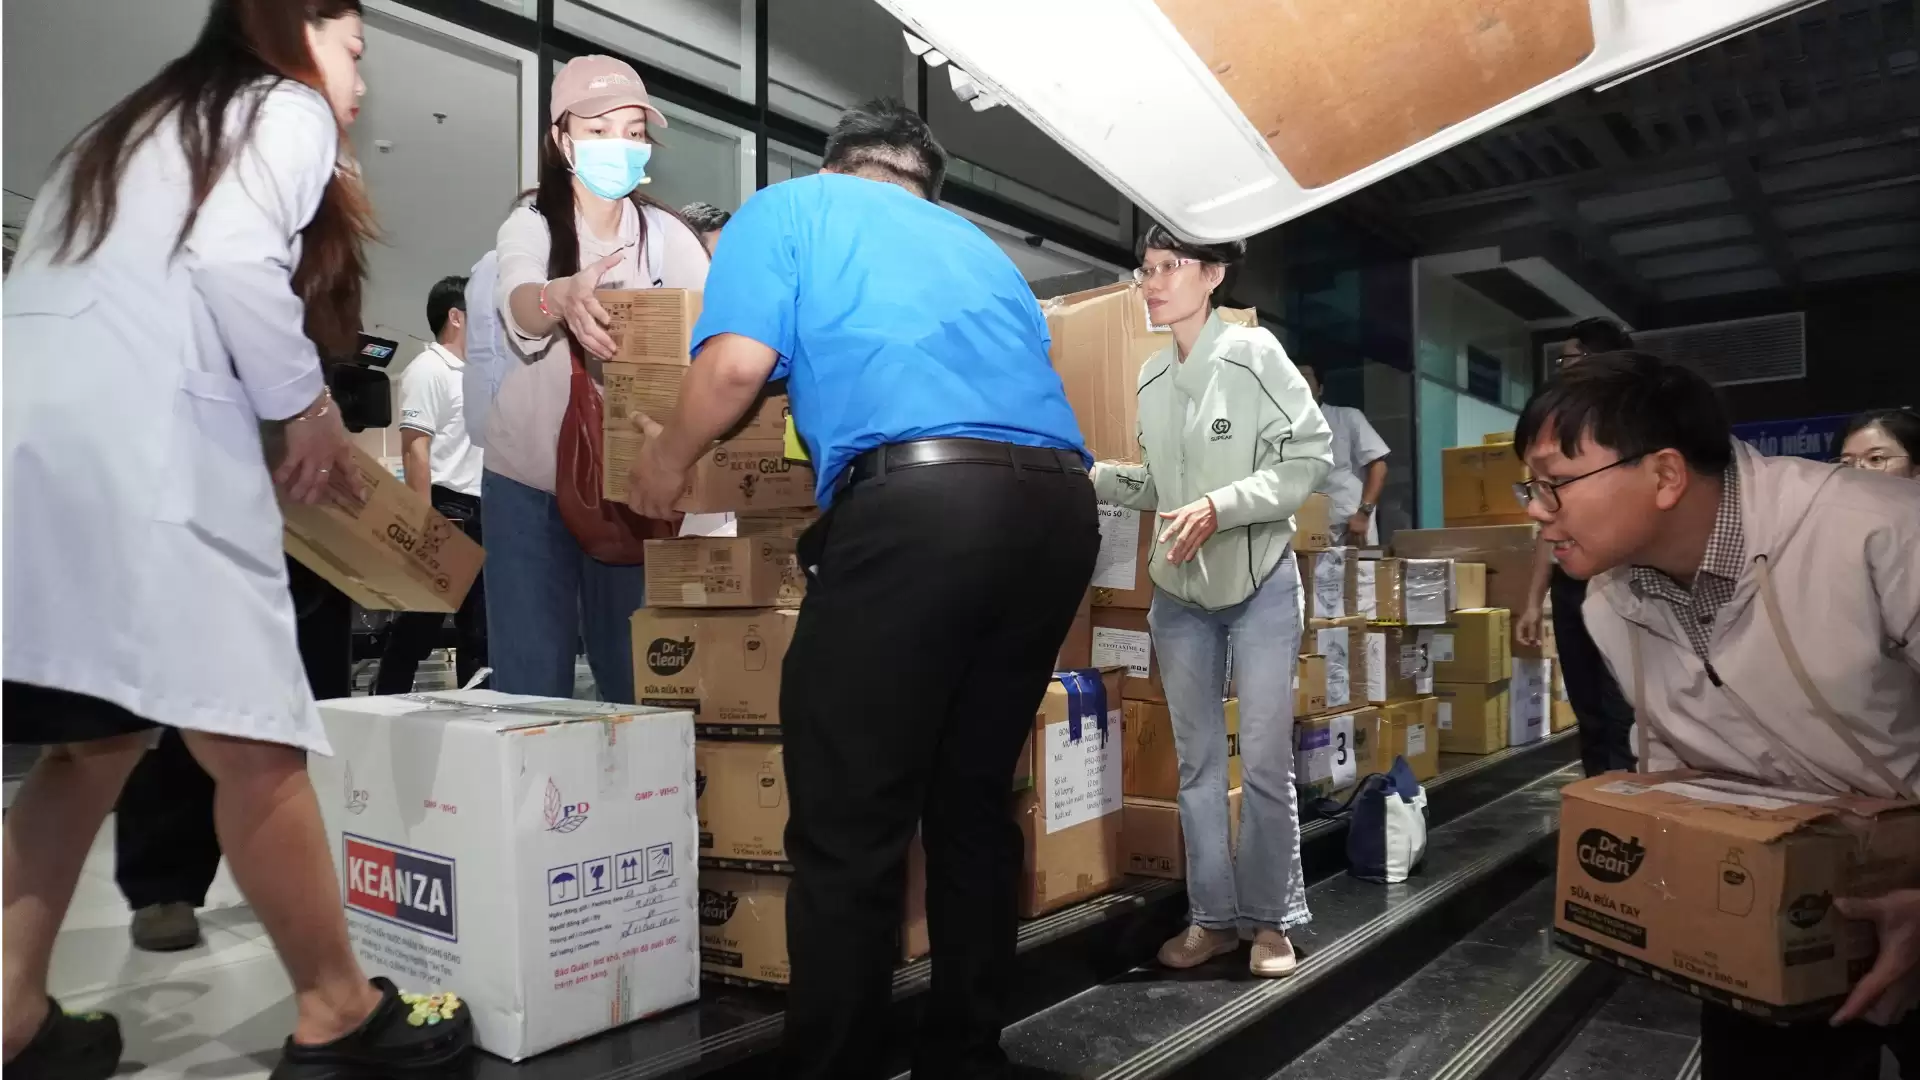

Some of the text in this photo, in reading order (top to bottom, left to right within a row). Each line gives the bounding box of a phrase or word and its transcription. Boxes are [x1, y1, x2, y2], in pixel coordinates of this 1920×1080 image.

[662, 642, 675, 654] Dr
[649, 652, 685, 667] Clean
[680, 686, 696, 695] TAY
[1337, 732, 1347, 766] 3
[563, 802, 590, 817] PD
[1600, 836, 1618, 854] Dr
[1580, 844, 1630, 877] Clean
[349, 855, 448, 917] KEANZA
[700, 900, 729, 920] lean
[1620, 903, 1640, 918] TAY
